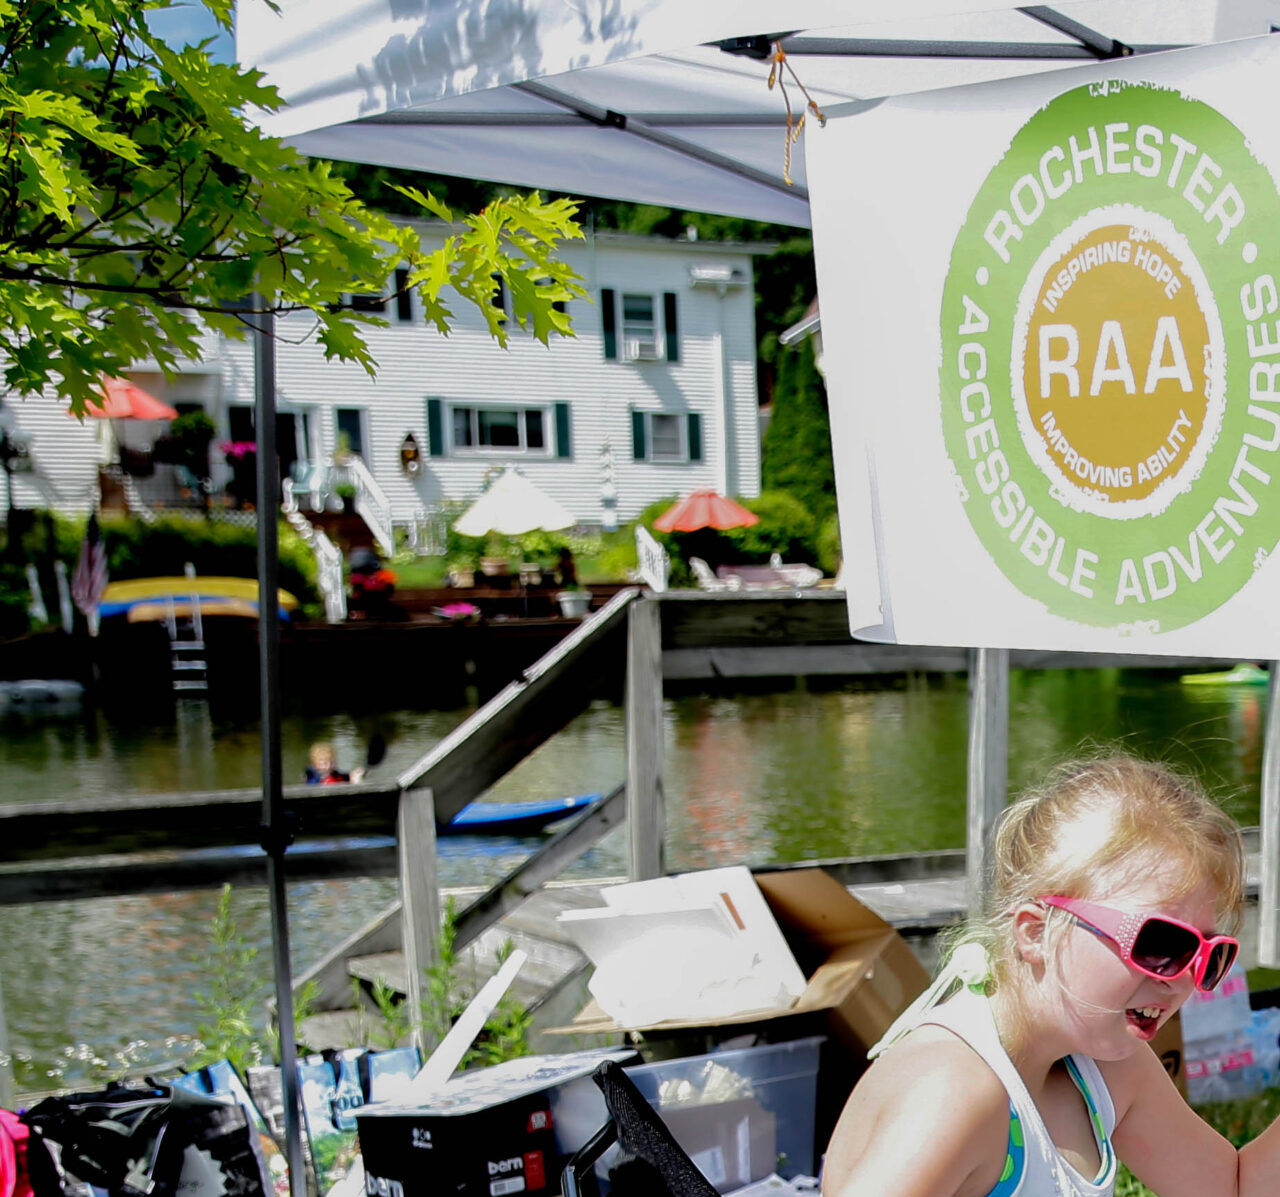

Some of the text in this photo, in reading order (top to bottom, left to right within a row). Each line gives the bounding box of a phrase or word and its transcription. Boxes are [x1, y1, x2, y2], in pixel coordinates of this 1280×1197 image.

[983, 122, 1246, 263] ROCHESTER
[1041, 241, 1182, 313] INSPIRING HOPE
[1038, 316, 1193, 399] RAA
[958, 294, 1099, 599] ACCESSIBLE
[1040, 408, 1193, 488] IMPROVING ABILITY
[488, 1156, 524, 1175] bern
